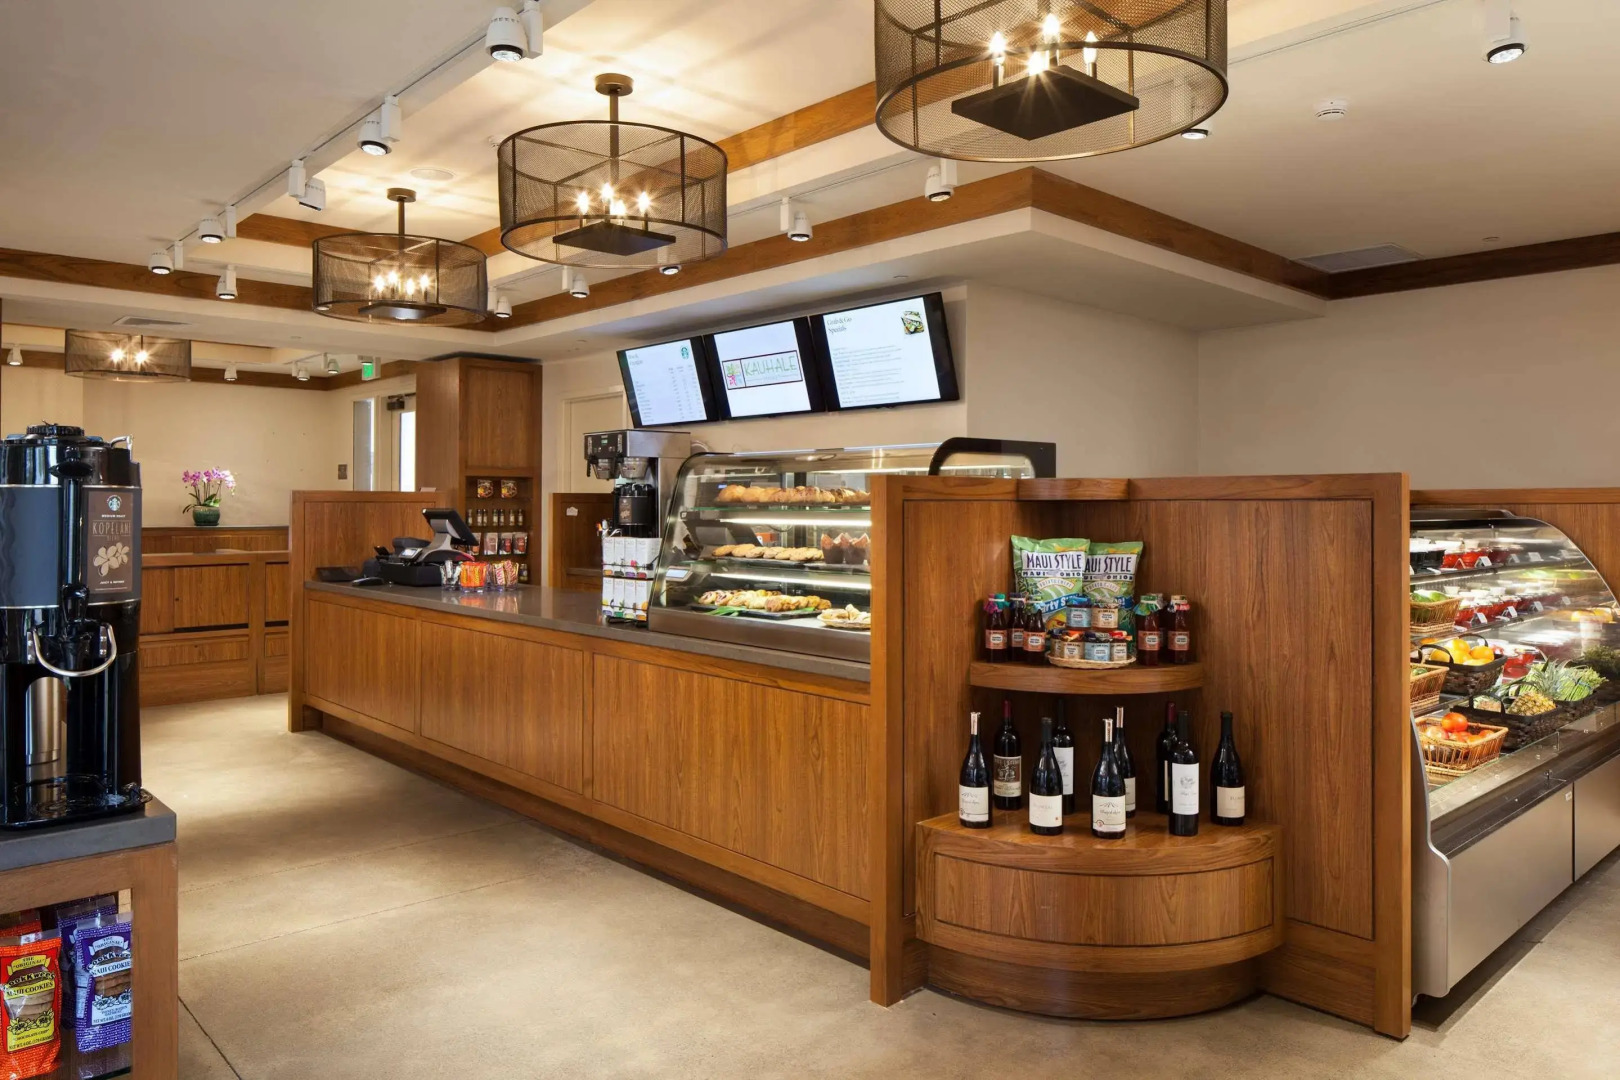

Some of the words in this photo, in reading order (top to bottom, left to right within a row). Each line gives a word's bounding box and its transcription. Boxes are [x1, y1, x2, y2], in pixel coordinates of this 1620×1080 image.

[744, 356, 797, 376] KAUHALE
[1026, 553, 1053, 569] MAUI
[1054, 553, 1082, 570] STYLE
[1084, 558, 1101, 573] AUI
[1103, 556, 1131, 573] STYLE
[108, 960, 131, 972] COOKIE
[25, 981, 54, 994] COOKIES
